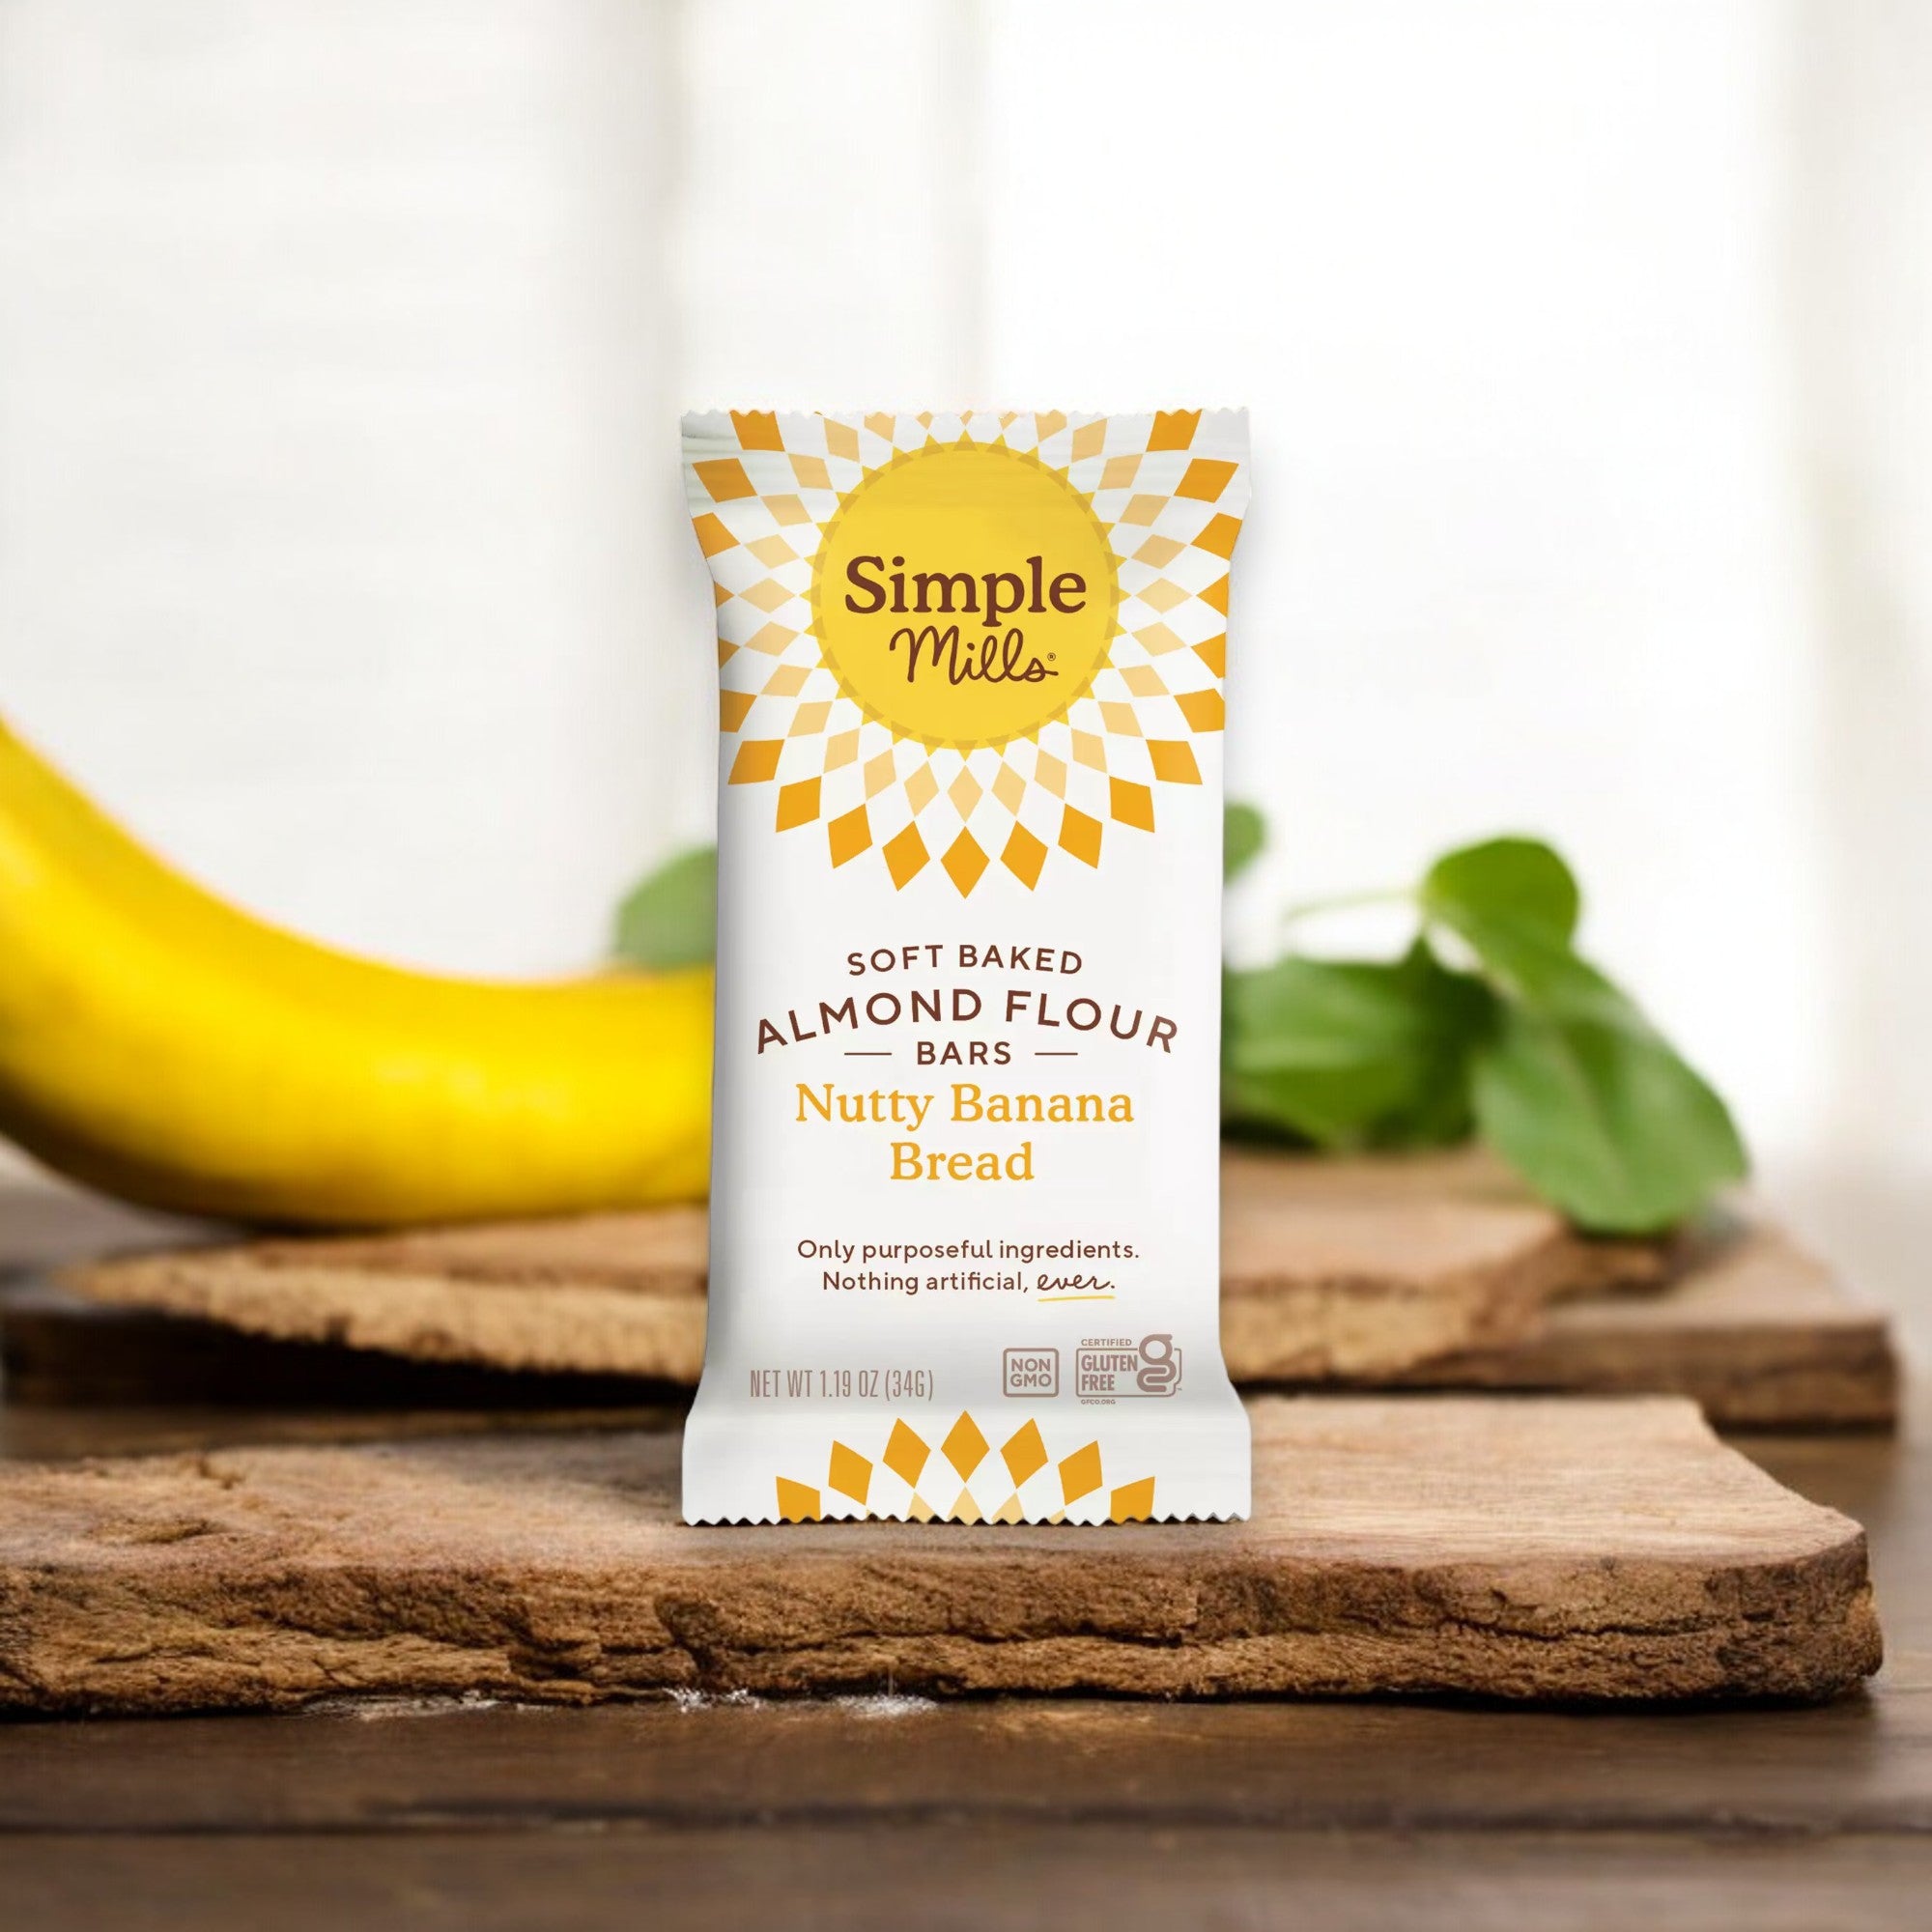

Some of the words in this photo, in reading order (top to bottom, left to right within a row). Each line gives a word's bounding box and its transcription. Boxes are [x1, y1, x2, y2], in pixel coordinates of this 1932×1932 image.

[844, 555, 1087, 628] Simple
[847, 944, 944, 977] SOFT
[958, 944, 1083, 975] BAKED
[757, 988, 982, 1055] ALMOND
[1005, 989, 1178, 1054] FLOUR
[917, 1040, 1011, 1065] BARS
[795, 1083, 935, 1132] Nutty
[950, 1083, 1135, 1123] Banana
[890, 1141, 1035, 1181] Bread
[797, 1239, 856, 1264] Only
[863, 1239, 993, 1264] purposeful
[999, 1239, 1139, 1264] ingredients.
[823, 1271, 919, 1296] Nothing
[925, 1271, 1029, 1293] artificial,
[1037, 1273, 1116, 1292] ever.
[1080, 1338, 1132, 1347] CERTIFIED
[1010, 1357, 1051, 1373] NON
[1080, 1354, 1138, 1373] GLUTEN
[750, 1369, 781, 1398] NET
[786, 1369, 813, 1398] WT
[819, 1370, 851, 1398] 1.19
[858, 1369, 879, 1398] OZ
[885, 1369, 934, 1402] (34G)
[1009, 1373, 1052, 1388] GMO
[1081, 1374, 1115, 1392] FREE
